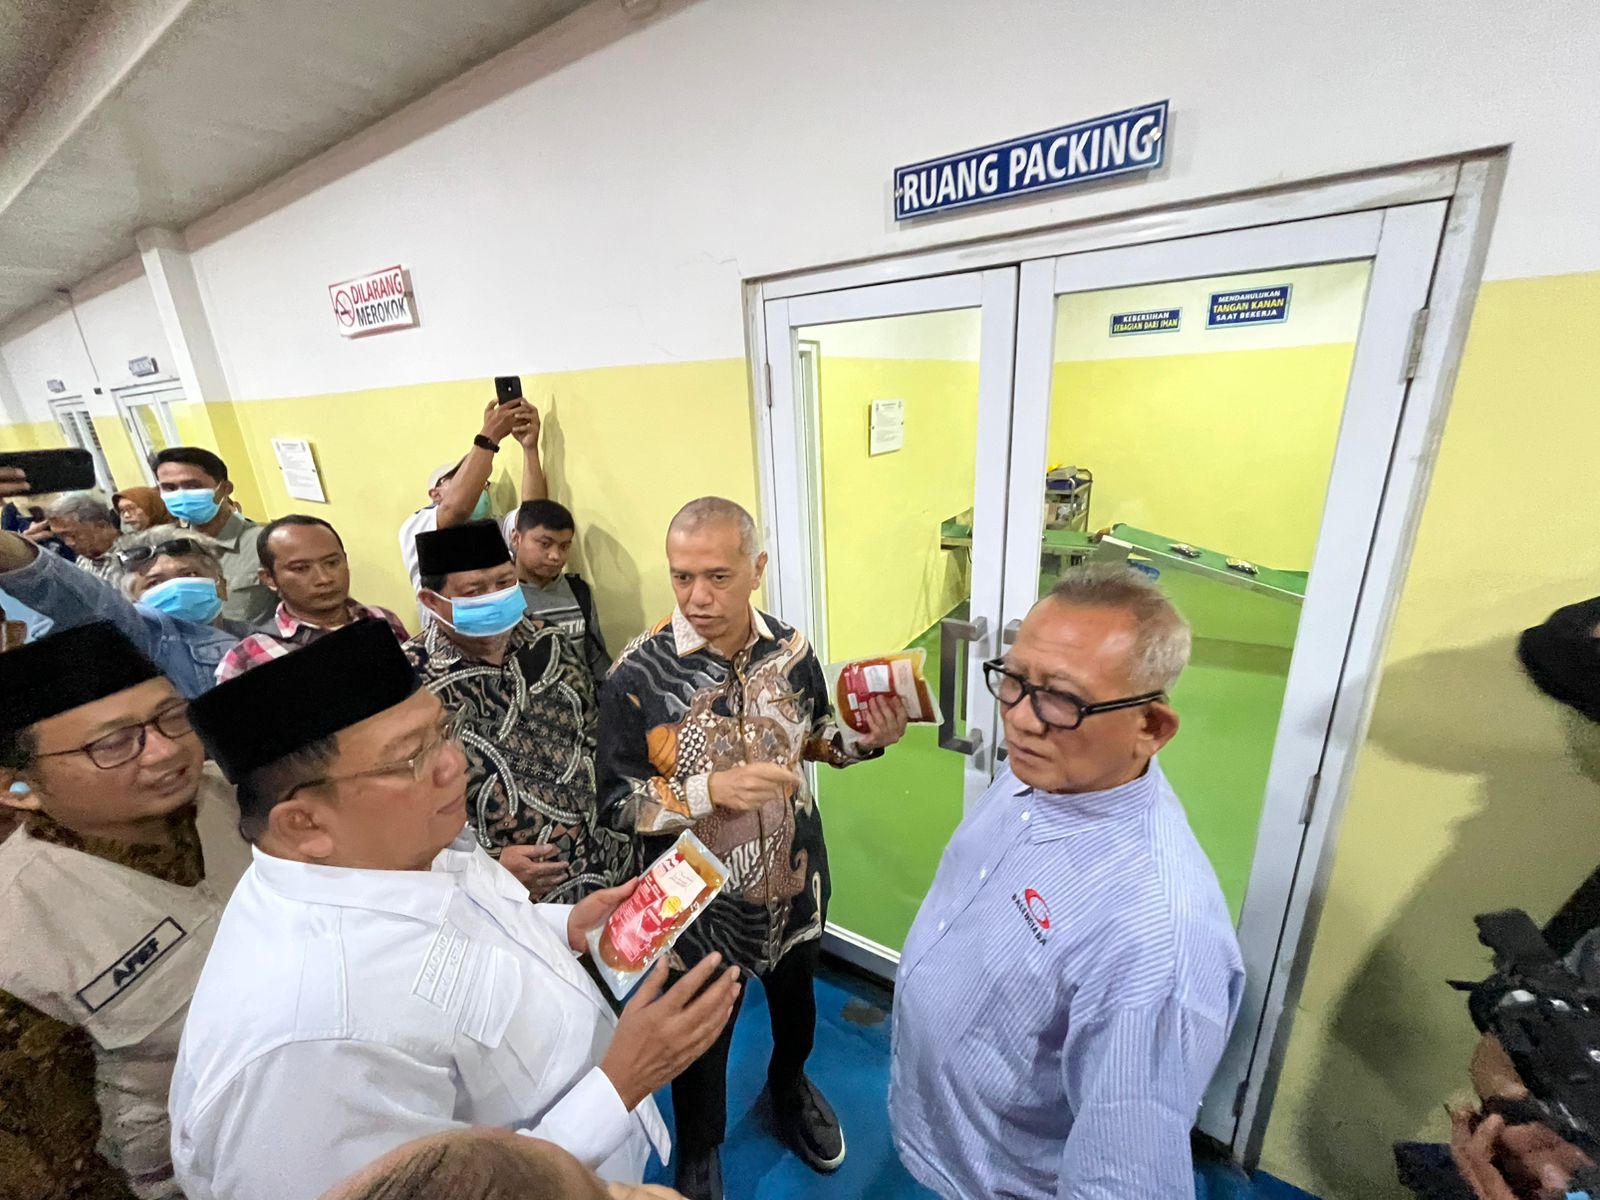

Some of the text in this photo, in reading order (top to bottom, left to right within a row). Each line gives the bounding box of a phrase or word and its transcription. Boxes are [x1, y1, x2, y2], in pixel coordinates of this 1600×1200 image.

[903, 115, 1156, 211] RUANG PACKING
[350, 273, 403, 305] DILARANG
[1218, 290, 1281, 303] MENDAHULUKAN
[355, 297, 407, 327] MEROKOK
[1213, 298, 1284, 314] TANGAN KANAN
[1123, 311, 1169, 323] KEBERSIHAN
[1216, 309, 1277, 322] SAAT BEKERJA
[1114, 319, 1178, 333] SEBAGIAN DARI IMAN
